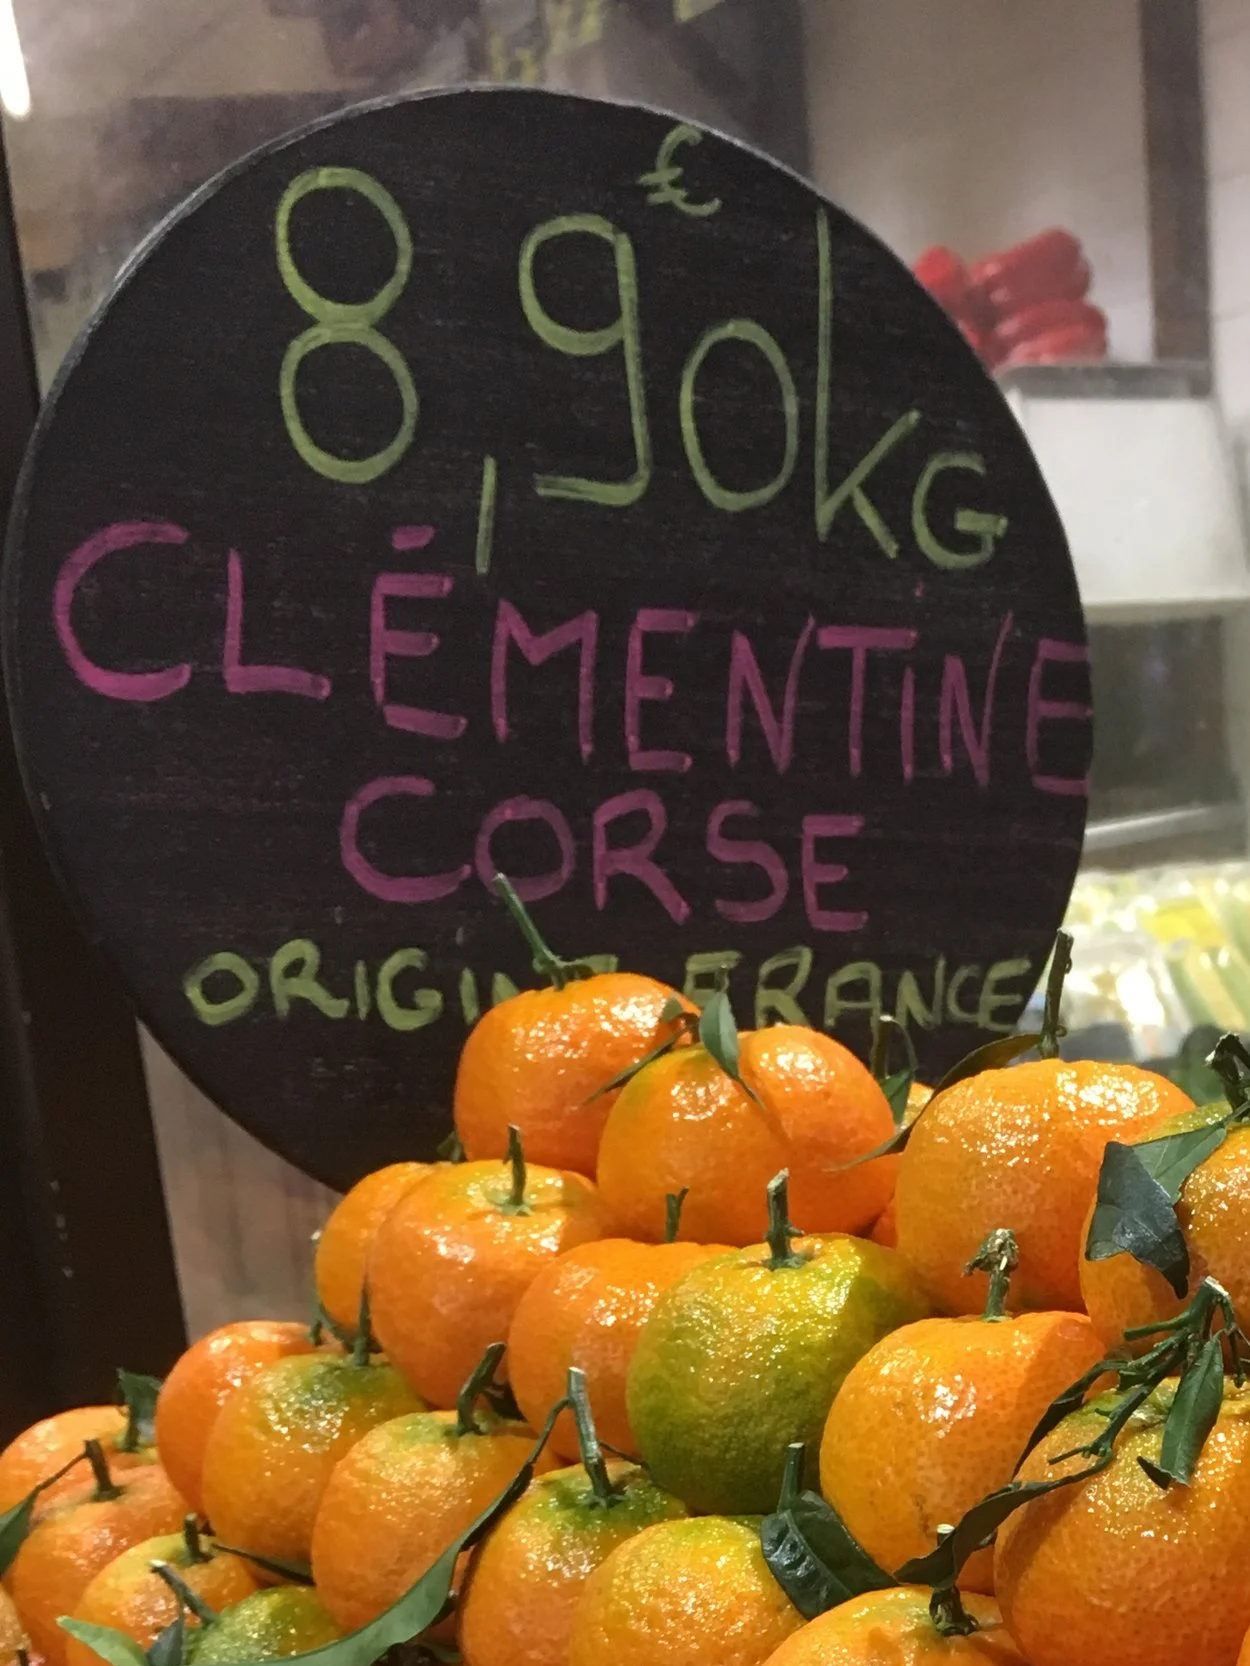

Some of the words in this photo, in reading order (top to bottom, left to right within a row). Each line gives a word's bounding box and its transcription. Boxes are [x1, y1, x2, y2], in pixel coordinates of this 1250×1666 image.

[636, 124, 722, 219] €
[338, 775, 869, 934] CORSE
[682, 944, 1033, 1034] FRANCE
